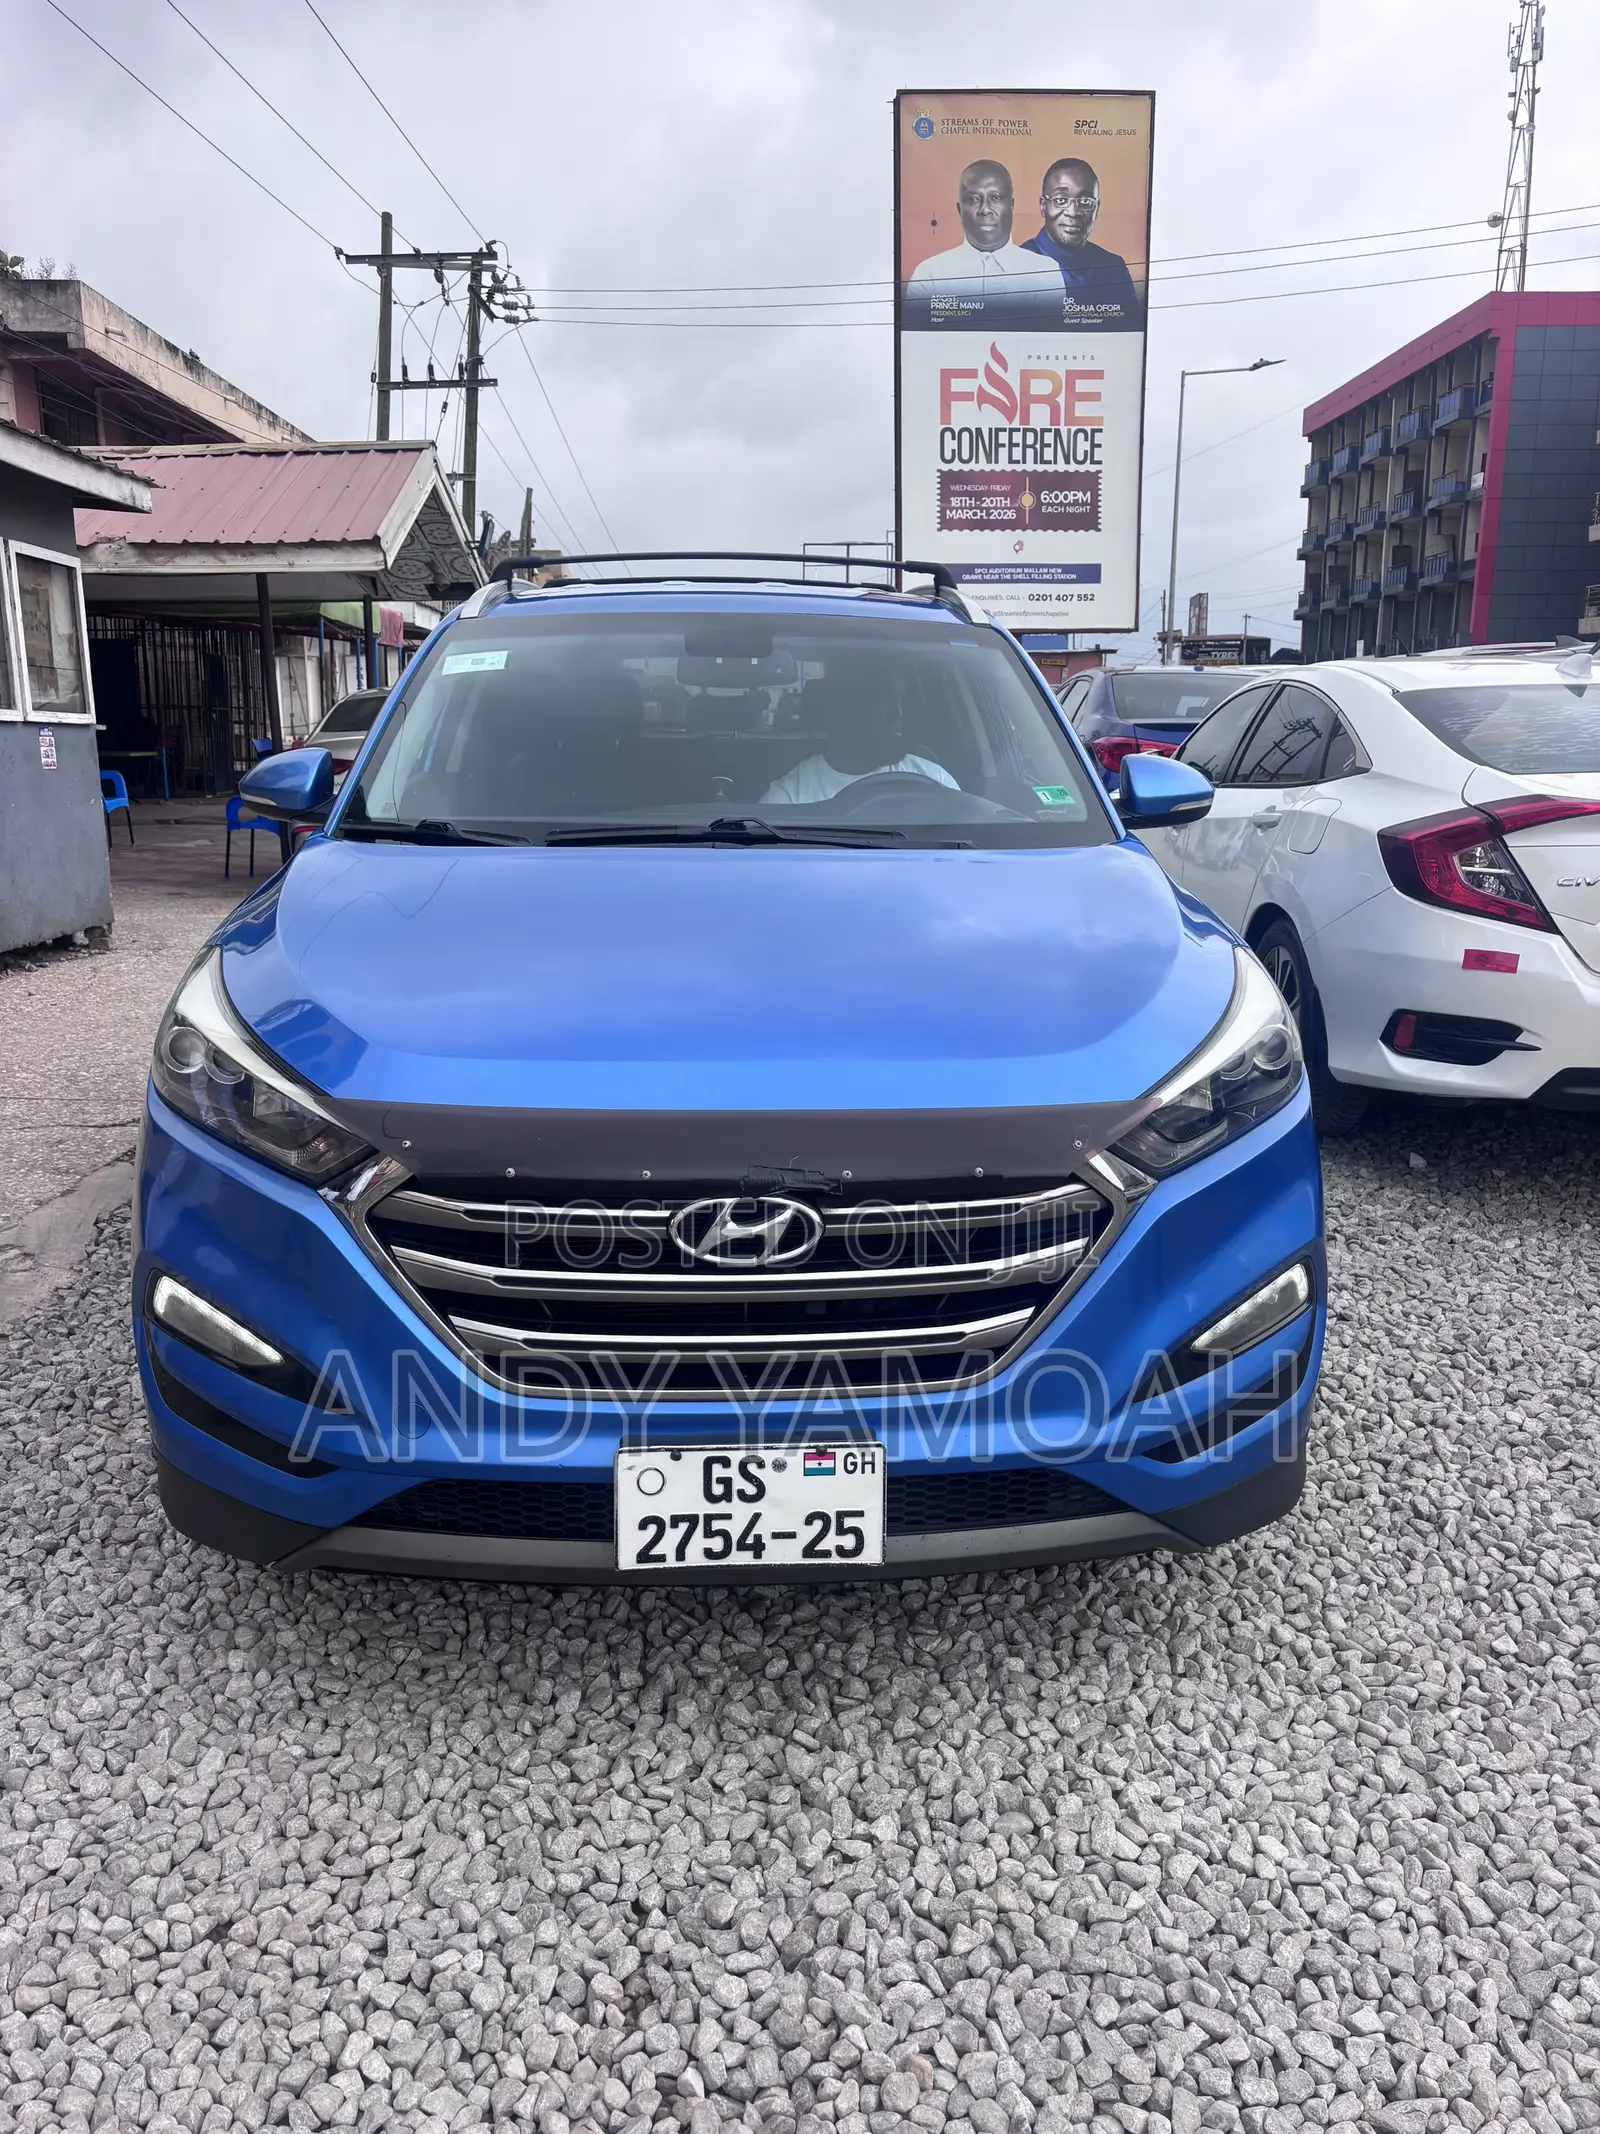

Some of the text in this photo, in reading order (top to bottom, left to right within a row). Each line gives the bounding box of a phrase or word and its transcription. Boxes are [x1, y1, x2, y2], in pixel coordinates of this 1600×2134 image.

[940, 118, 1029, 128] STREAMS OF POWER
[1074, 119, 1098, 129] SPCI
[940, 126, 1033, 136] CHAPEL INTERNATIONAL
[930, 302, 985, 310] PRINCE MANU
[1062, 297, 1076, 305] DR.
[1062, 304, 1121, 312] JOSHUA OFORI
[939, 426, 1103, 465] CONFERENCE
[1040, 490, 1091, 504] 6:00PM
[950, 497, 975, 508] 18TH
[981, 497, 1011, 508] 20TH
[990, 509, 1017, 520] 2026
[1028, 593, 1053, 602] 0201
[1055, 593, 1075, 602] 407
[1076, 593, 1096, 602] 552
[702, 1451, 876, 1504] GS GH
[636, 1510, 865, 1564] 2754-25
